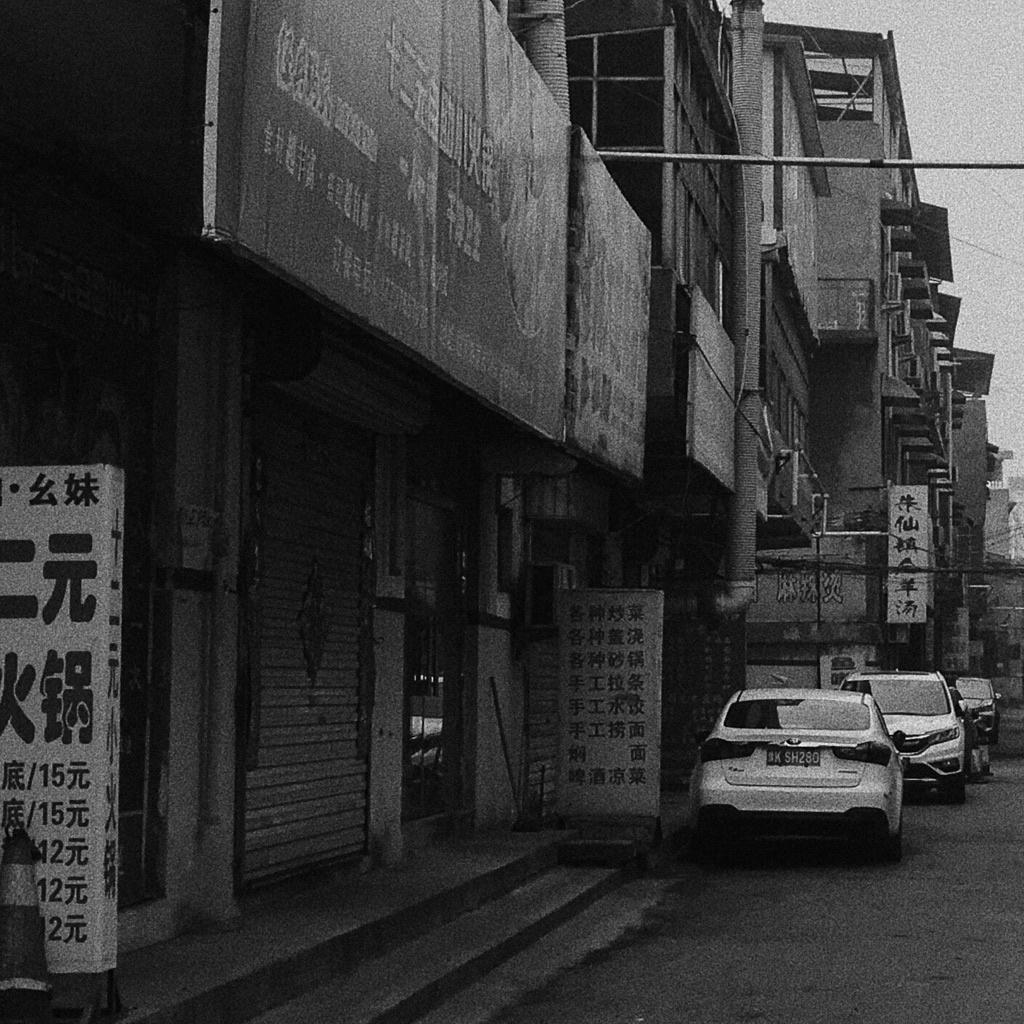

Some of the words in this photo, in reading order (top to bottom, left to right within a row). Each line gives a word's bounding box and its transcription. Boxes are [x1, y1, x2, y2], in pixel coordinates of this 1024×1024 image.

[0, 472, 99, 507] ·幺妹
[568, 604, 644, 623] 各种炒菜
[568, 651, 645, 669] 各种砂锅
[568, 674, 645, 692] 手工拉条
[568, 721, 646, 739] 手工捞面
[568, 767, 646, 786] 啤酒凉菜
[46, 915, 88, 944] 2元
